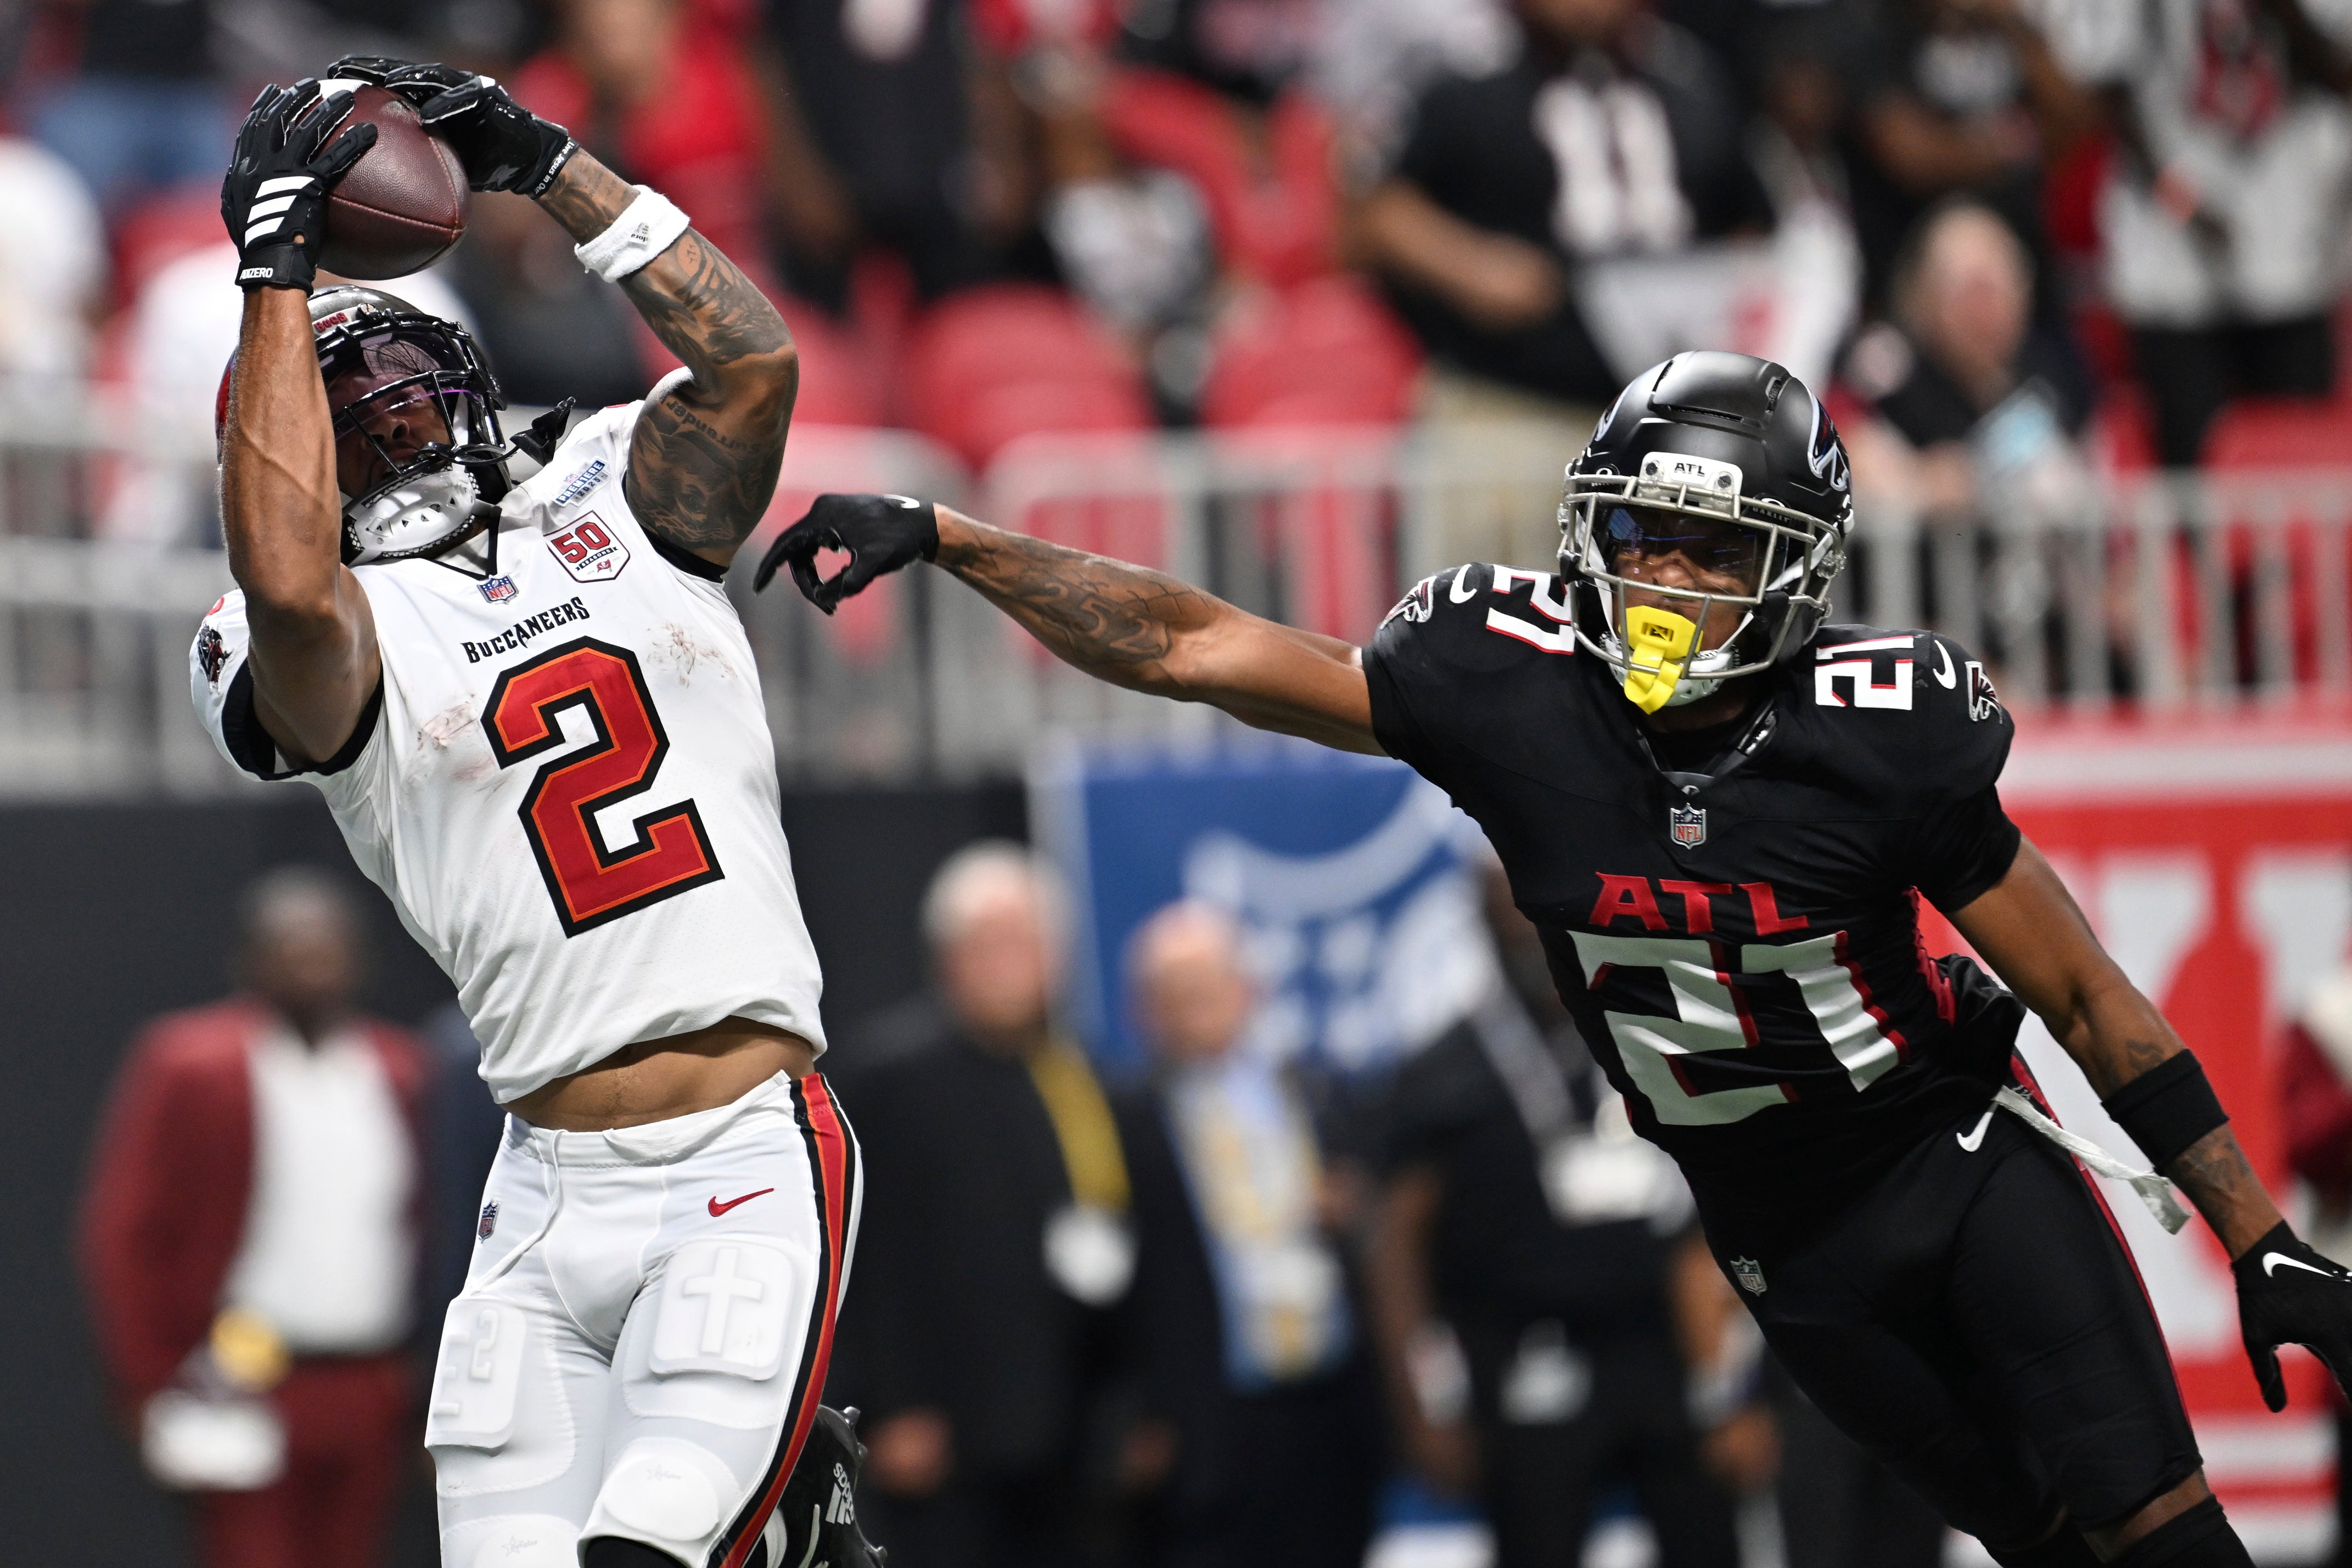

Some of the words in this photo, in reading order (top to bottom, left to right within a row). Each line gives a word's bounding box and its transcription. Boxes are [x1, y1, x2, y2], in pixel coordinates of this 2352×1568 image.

[562, 141, 575, 154] Live
[549, 154, 564, 175] Jesus
[543, 175, 552, 186] in
[1674, 462, 1705, 476] ATL
[551, 521, 611, 563] 50
[581, 549, 611, 567] SEASONS
[487, 585, 514, 599] NFL
[460, 596, 590, 664] BUCCANEERS
[1815, 635, 1914, 711] 27
[480, 635, 725, 938] 2
[1677, 825, 1700, 842] NFL
[1589, 872, 1809, 935] ATL
[1567, 930, 1911, 1126] 27
